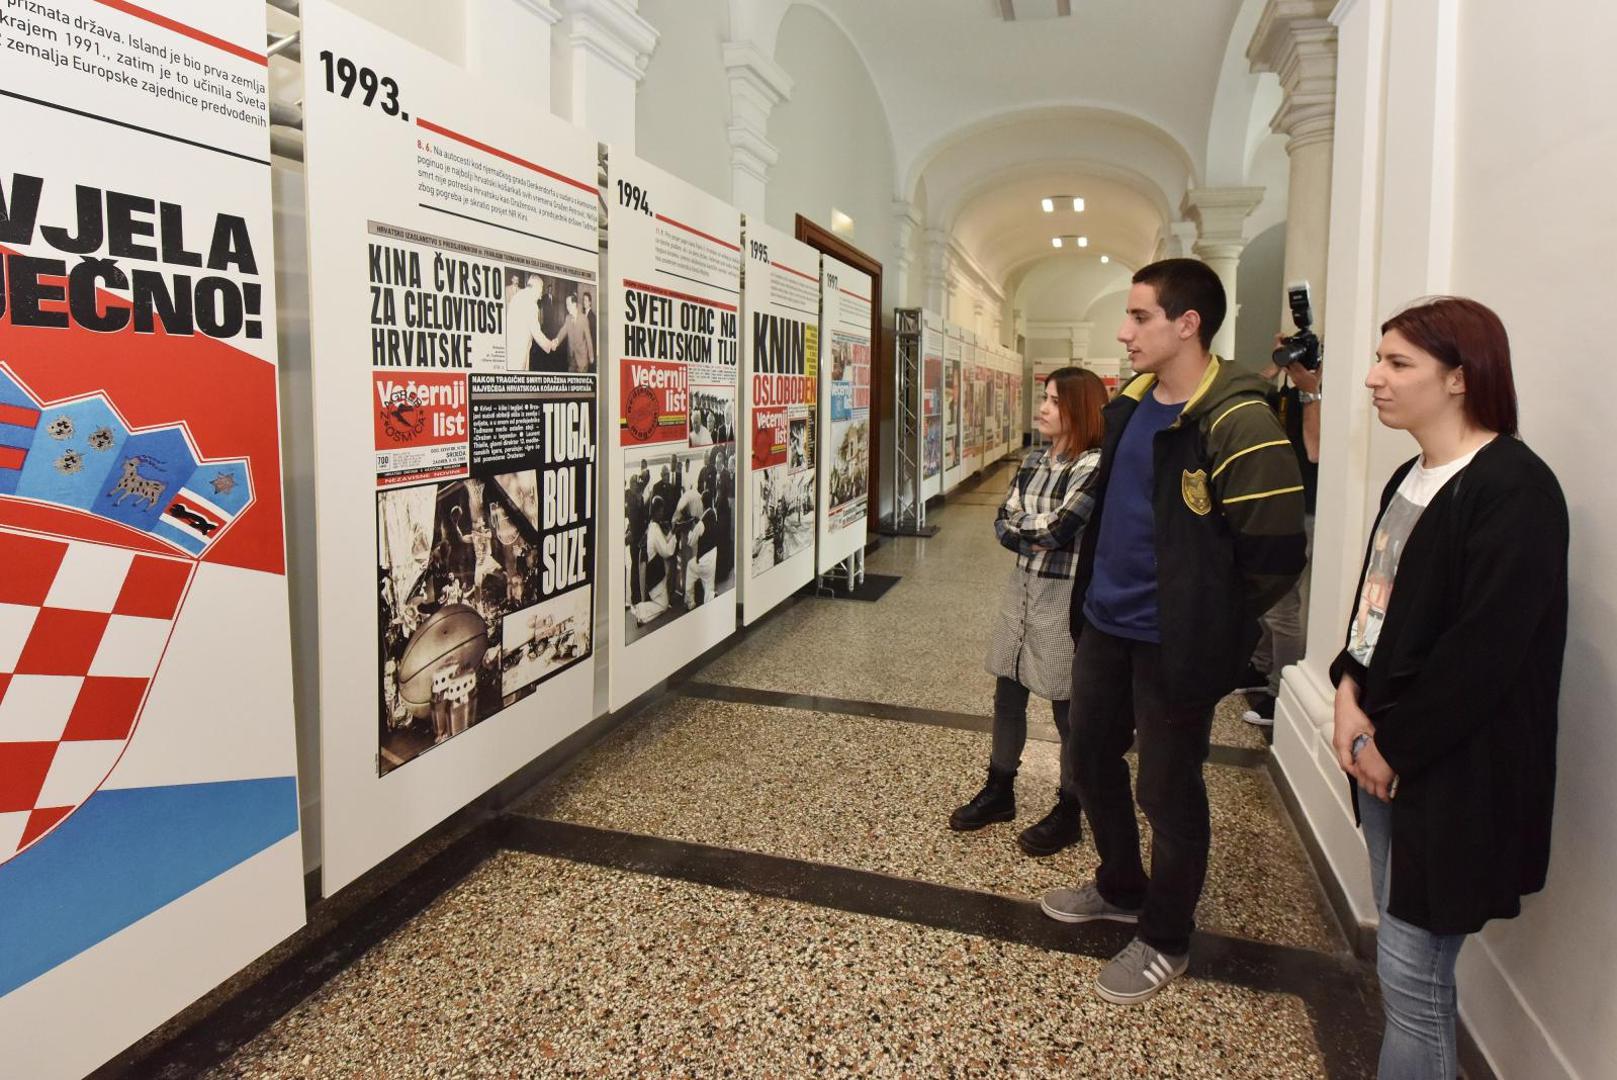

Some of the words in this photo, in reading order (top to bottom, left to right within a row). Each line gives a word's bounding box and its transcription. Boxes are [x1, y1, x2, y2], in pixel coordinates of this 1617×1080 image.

[0, 10, 57, 42] krajem
[65, 31, 111, 63] 1991.,
[116, 50, 155, 74] zatim
[159, 66, 171, 81] je
[176, 69, 189, 85] to
[193, 76, 232, 100] učinila
[236, 91, 266, 111] Sveta
[74, 15, 125, 45] država.
[128, 33, 167, 59] Island
[169, 51, 181, 66] je
[183, 53, 201, 71] bio
[204, 62, 229, 83] prva
[231, 72, 266, 94] zemlja
[6, 36, 69, 67] zemalja
[73, 59, 138, 89] Europske
[141, 79, 198, 107] zajednice
[201, 98, 267, 128] predvođenih
[320, 50, 409, 122] 1993.
[417, 155, 444, 171] poginuo
[433, 145, 443, 157] Na
[418, 170, 434, 180] smrt
[447, 180, 473, 193] potresla
[418, 183, 434, 196] zbog
[436, 189, 462, 202] pogreba
[618, 179, 653, 217] 1994.
[750, 240, 769, 263] 1995.
[369, 243, 421, 288] KINA
[434, 251, 501, 300] ČVRSTO
[370, 286, 397, 326] ZA
[404, 290, 504, 334] CJELOVITOST
[625, 289, 672, 328] SVETI
[681, 302, 715, 336] OTAC
[720, 311, 736, 339] NA
[372, 328, 473, 368] HRVATSKE
[624, 324, 712, 364] HRVATSKOM
[718, 339, 736, 366] TLU
[753, 312, 805, 374] KNIN
[377, 380, 465, 409] Večernji
[472, 384, 505, 392] NAJVEĆEGA
[540, 384, 567, 392] KOŠARKAŠA
[496, 375, 525, 384] TRAGIČNE
[543, 376, 566, 384] DRAŽENA
[631, 365, 686, 392] Večernji
[666, 390, 686, 412] list
[433, 412, 465, 437] list
[543, 402, 595, 463] TUGA,
[384, 473, 430, 484] NEZAVISNE
[543, 467, 578, 531] BOL
[585, 463, 592, 519] I
[542, 525, 587, 596] SUZE
